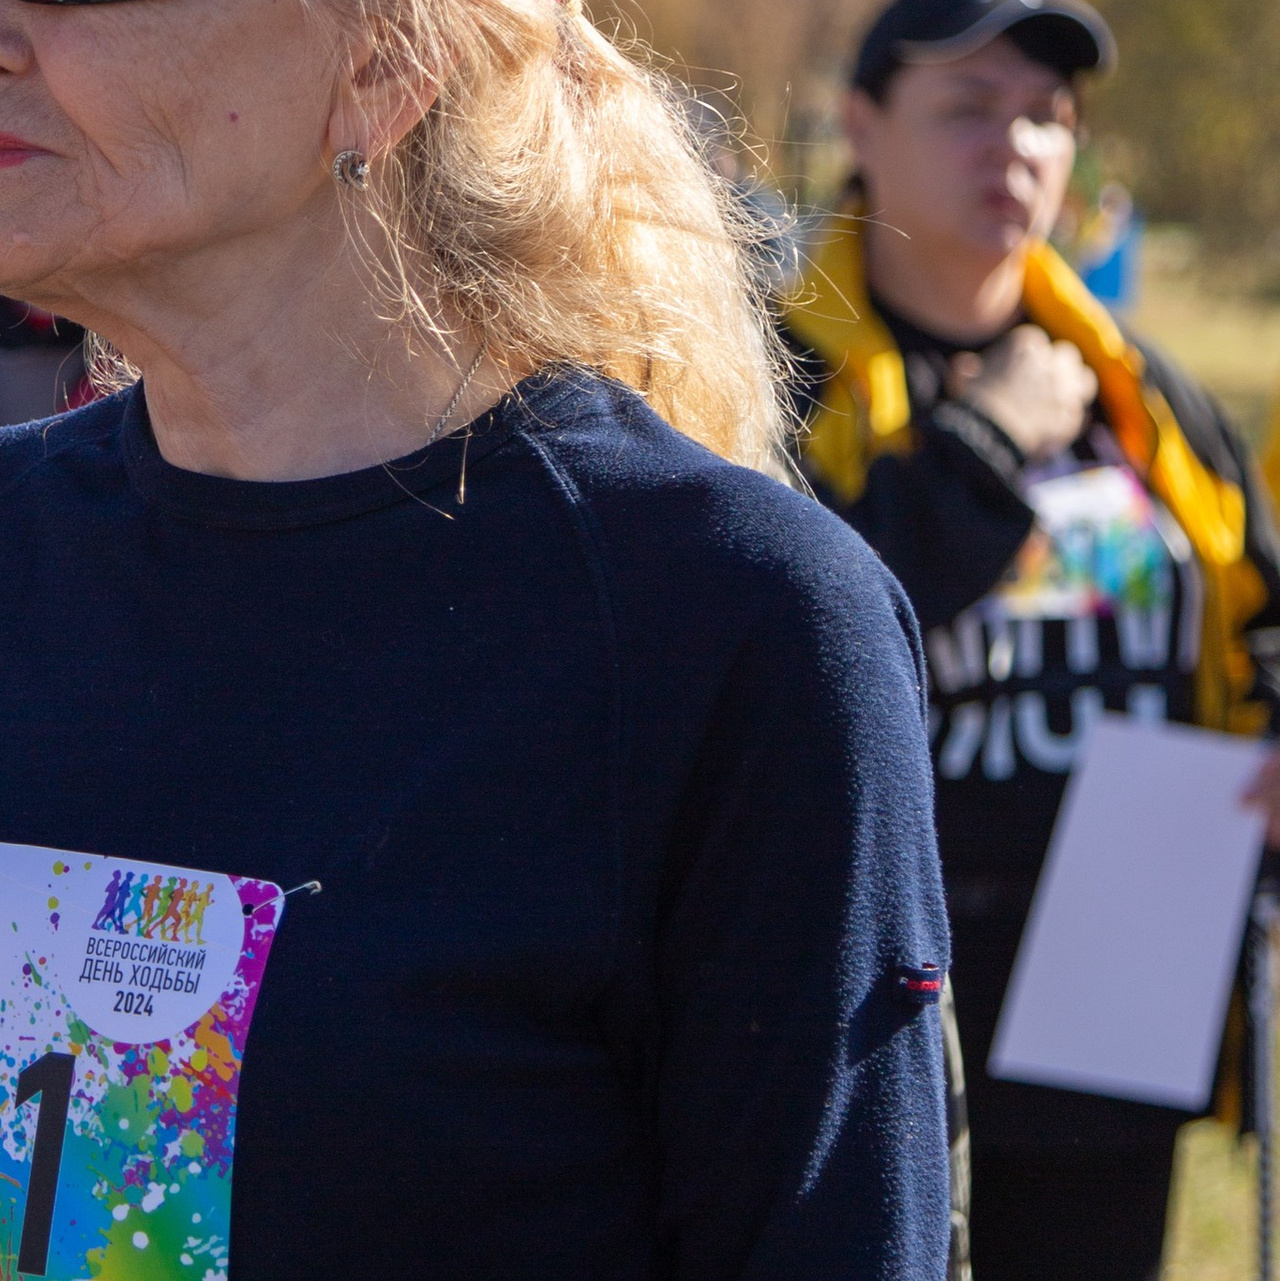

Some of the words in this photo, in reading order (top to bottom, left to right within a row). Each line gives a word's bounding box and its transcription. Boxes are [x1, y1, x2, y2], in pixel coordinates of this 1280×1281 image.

[86, 937, 206, 970] ВСЕРОССИЙСКИЙ
[79, 958, 123, 983] ДЕНЬ
[129, 964, 200, 994] ХОДЬБЫ
[113, 990, 153, 1016] 2024
